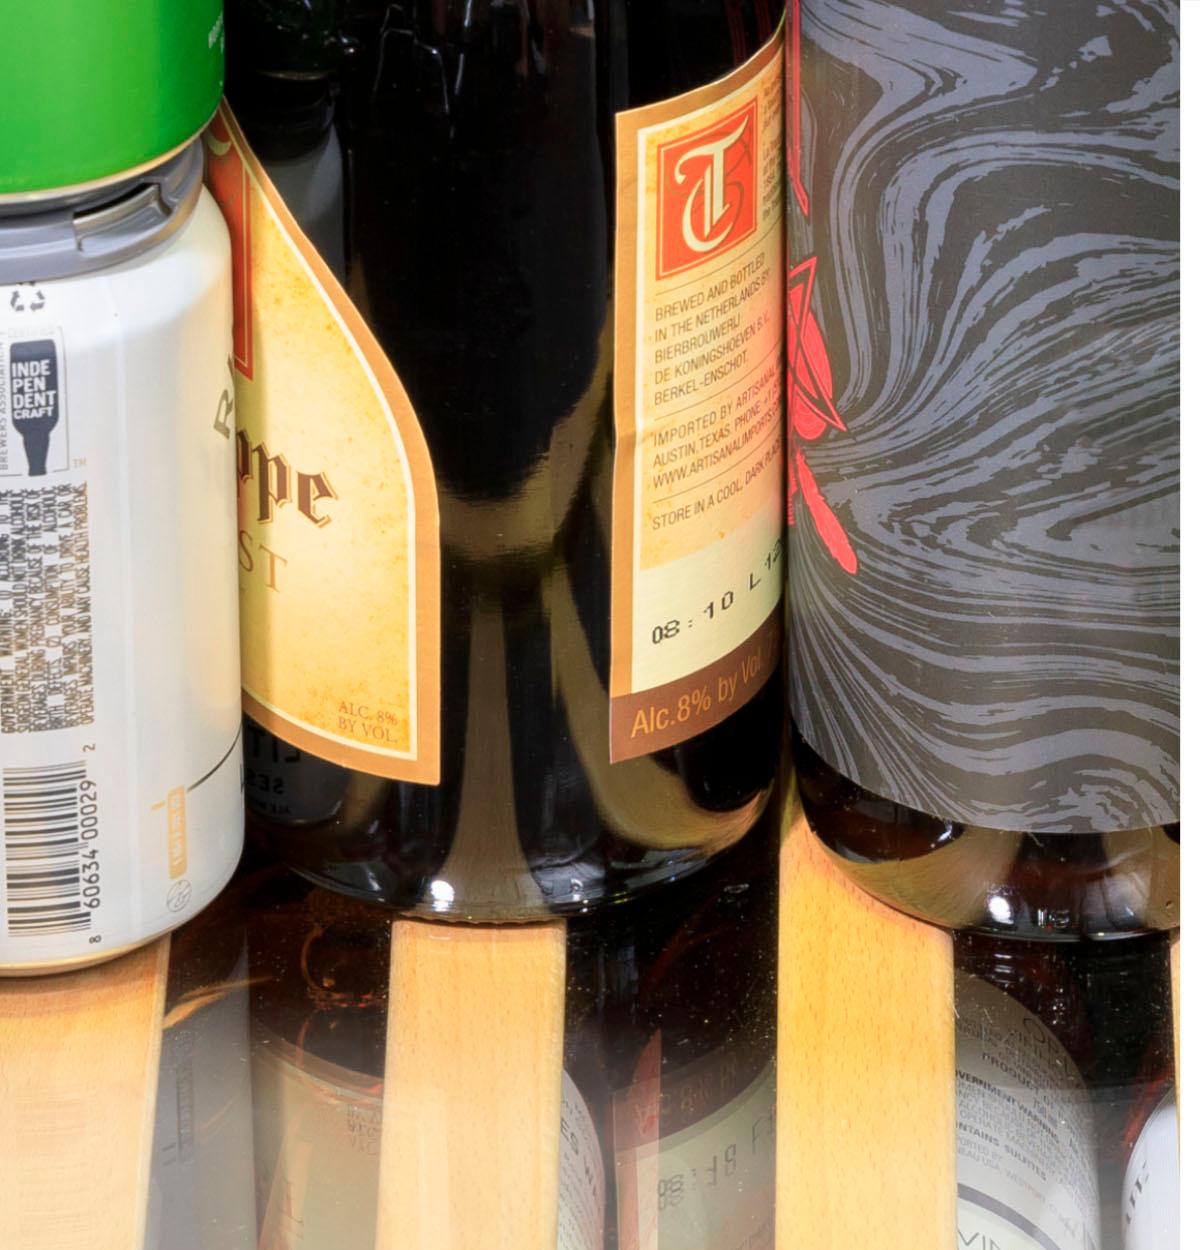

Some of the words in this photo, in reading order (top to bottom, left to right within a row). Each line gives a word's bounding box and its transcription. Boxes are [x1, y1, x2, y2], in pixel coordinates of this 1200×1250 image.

[656, 292, 704, 321] BREWED
[707, 279, 728, 302] AND
[731, 252, 765, 290] BOTTLED
[655, 327, 667, 343] IN
[671, 315, 693, 336] THE
[696, 278, 760, 326] NETHERLANDS
[655, 313, 741, 364] BIERBROUWERIJ
[655, 368, 671, 385] DE
[675, 321, 756, 378] KONINGSHOEVEN
[11, 359, 51, 378] INDE
[12, 377, 46, 393] PEN
[13, 390, 57, 408] DENT
[14, 406, 54, 420] CRAFT
[654, 410, 717, 447] IMPORTED
[720, 402, 733, 419] BY
[10, 489, 24, 535] ALCOHOLIC
[25, 502, 40, 521] RISK
[41, 486, 57, 532] ALCOHOLIC
[653, 504, 692, 531] STORE
[694, 498, 705, 515] IN
[707, 492, 715, 508] A
[10, 537, 25, 563] DRINK
[58, 534, 73, 559] DRIVE
[74, 531, 89, 563] HEALTH
[27, 557, 43, 595] BECAUSE
[74, 565, 90, 594] CAUSE
[12, 584, 27, 617] SHOULD
[43, 564, 58, 625] CONSUMPTION
[59, 580, 75, 609] ABILITY
[75, 596, 91, 613] MAY
[13, 619, 28, 652] WOMEN
[29, 597, 44, 647] PREGNANCY
[61, 613, 77, 636] YOUR
[76, 615, 92, 633] AND
[30, 649, 45, 682] DURING
[62, 641, 77, 676] IMPAIRS
[0, 669, 15, 734] GOVERNMENT
[63, 680, 79, 728] BEVERAGES
[718, 672, 738, 703] by
[15, 693, 30, 733] SURGEON
[30, 683, 46, 732] BEVERAGES
[47, 706, 63, 731] BIRTH
[79, 687, 94, 726] OPERATE
[338, 700, 373, 720] ALC.
[377, 710, 398, 727] 8%
[338, 716, 357, 733] BY
[82, 743, 96, 752] 2
[79, 780, 99, 841] 00029
[82, 849, 101, 909] 60634
[89, 935, 102, 944] 8
